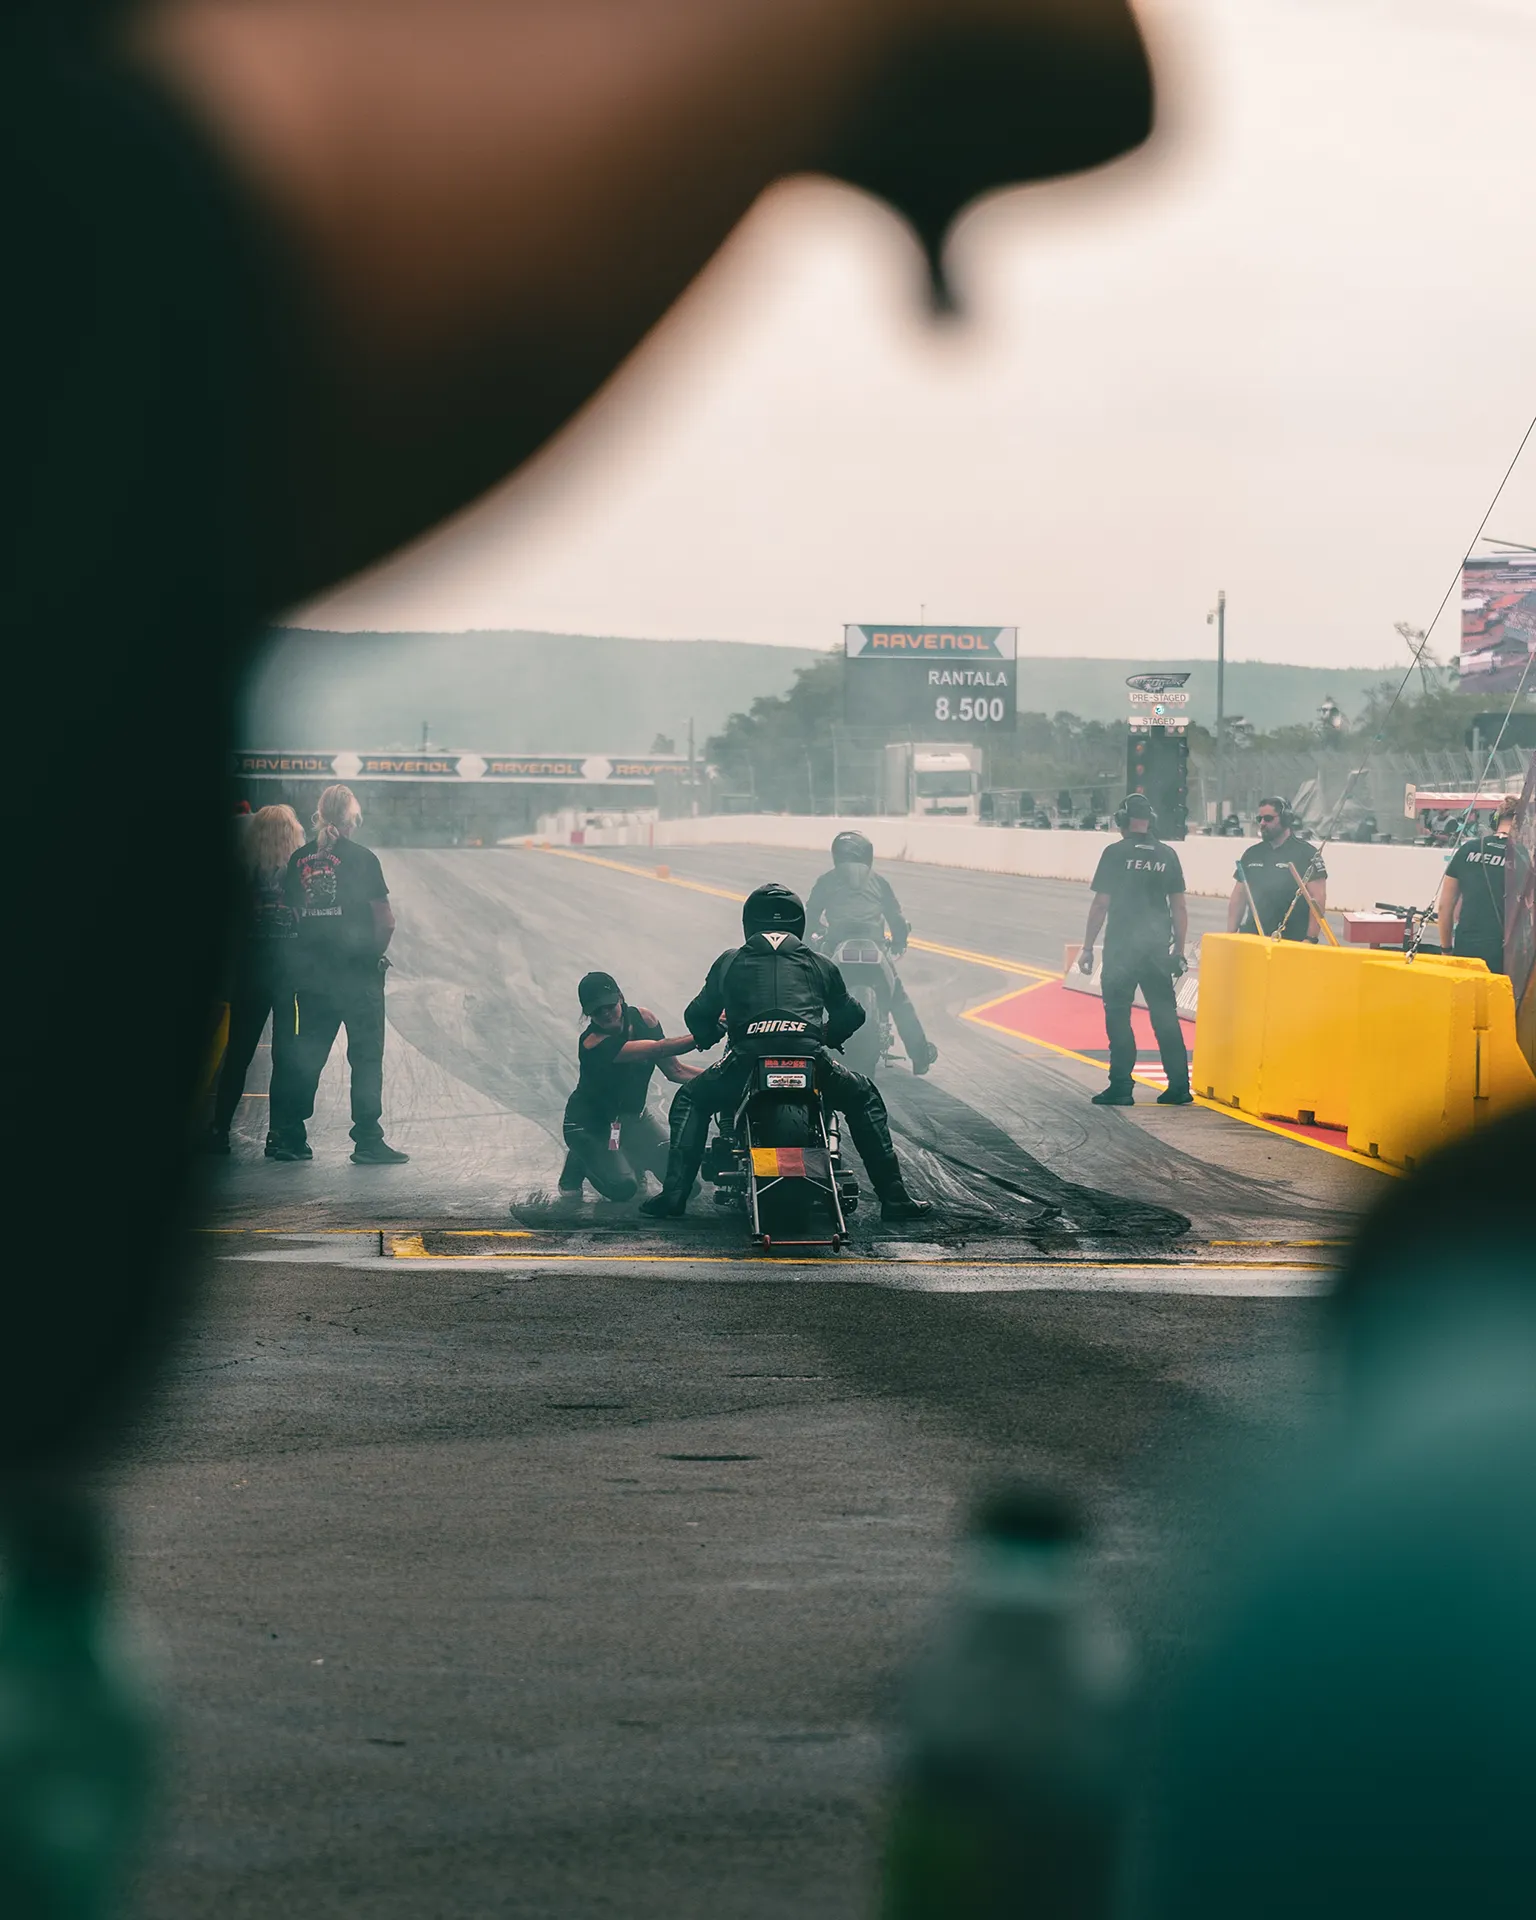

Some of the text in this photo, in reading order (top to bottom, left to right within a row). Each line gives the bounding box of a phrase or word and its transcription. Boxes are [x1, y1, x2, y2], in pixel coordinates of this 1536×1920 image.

[872, 633, 990, 650] RAVENOL
[928, 670, 1008, 687] RANTALA
[1132, 693, 1187, 702] PRE-STAGED
[934, 696, 1004, 722] 8.500
[1142, 717, 1176, 725] STAGED
[243, 759, 329, 771] RAVENOL
[366, 761, 453, 772] RAVENOL
[490, 762, 577, 774] RAVENOL
[1126, 859, 1166, 873] TEAM
[1466, 852, 1506, 867] MEDI
[747, 1020, 807, 1034] DAINESE
